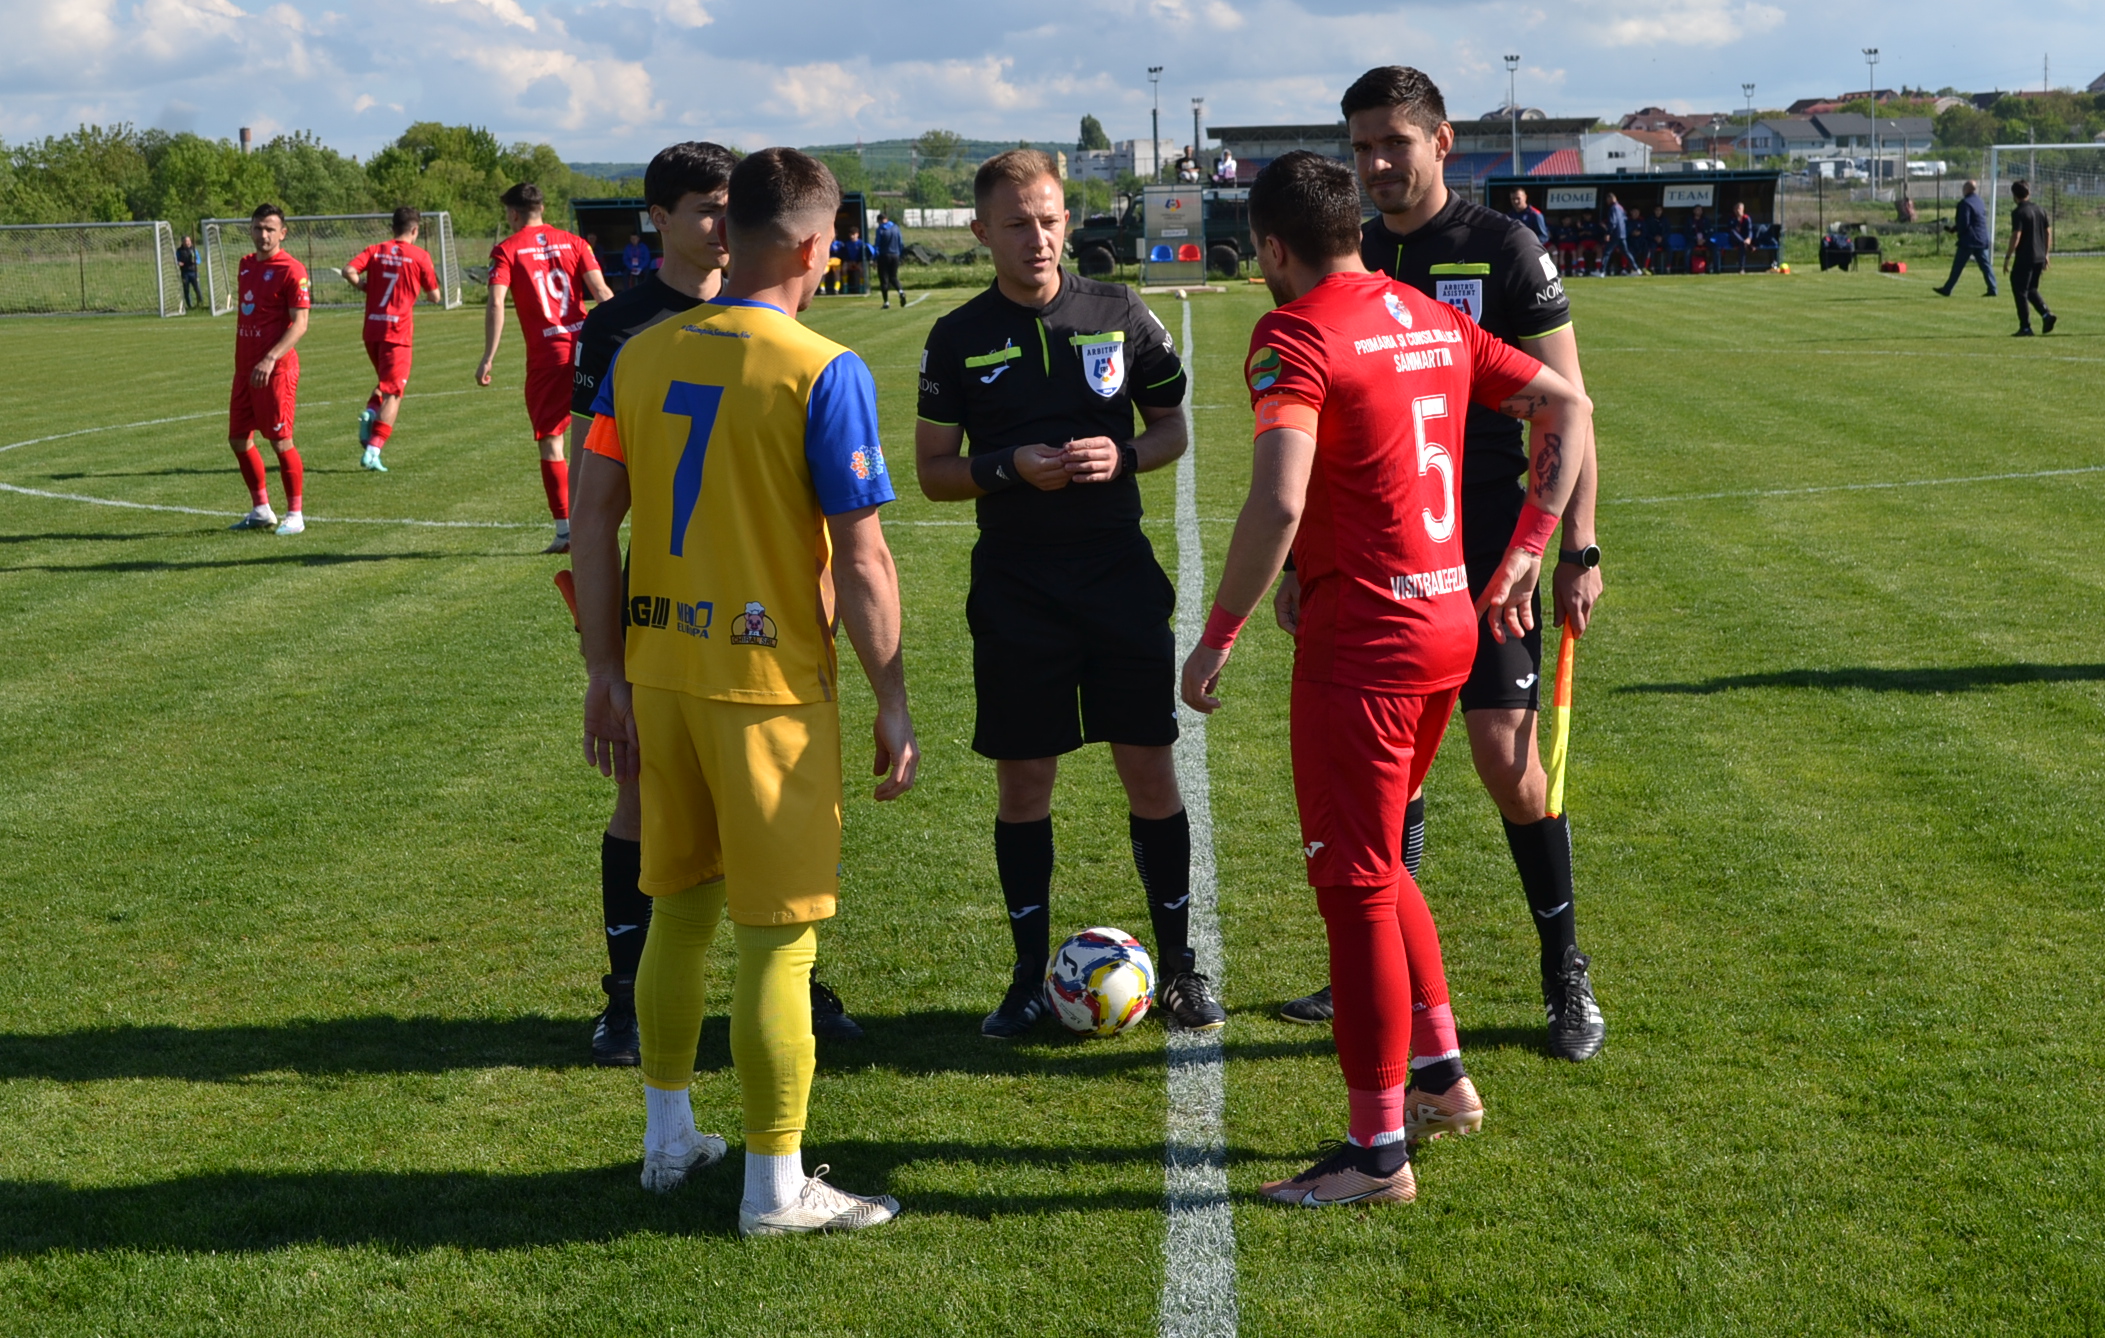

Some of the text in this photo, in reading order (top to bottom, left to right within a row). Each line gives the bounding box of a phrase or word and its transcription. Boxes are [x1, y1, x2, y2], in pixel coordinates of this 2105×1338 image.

[1550, 192, 1594, 204] HOME
[1667, 190, 1709, 201] TEAM
[379, 271, 400, 308] 7
[533, 267, 571, 319] 19
[1444, 283, 1474, 291] ARBITRU
[1087, 345, 1119, 356] ARBITRU
[573, 371, 595, 388] DIS
[662, 379, 725, 558] 7
[1412, 393, 1457, 544] 5
